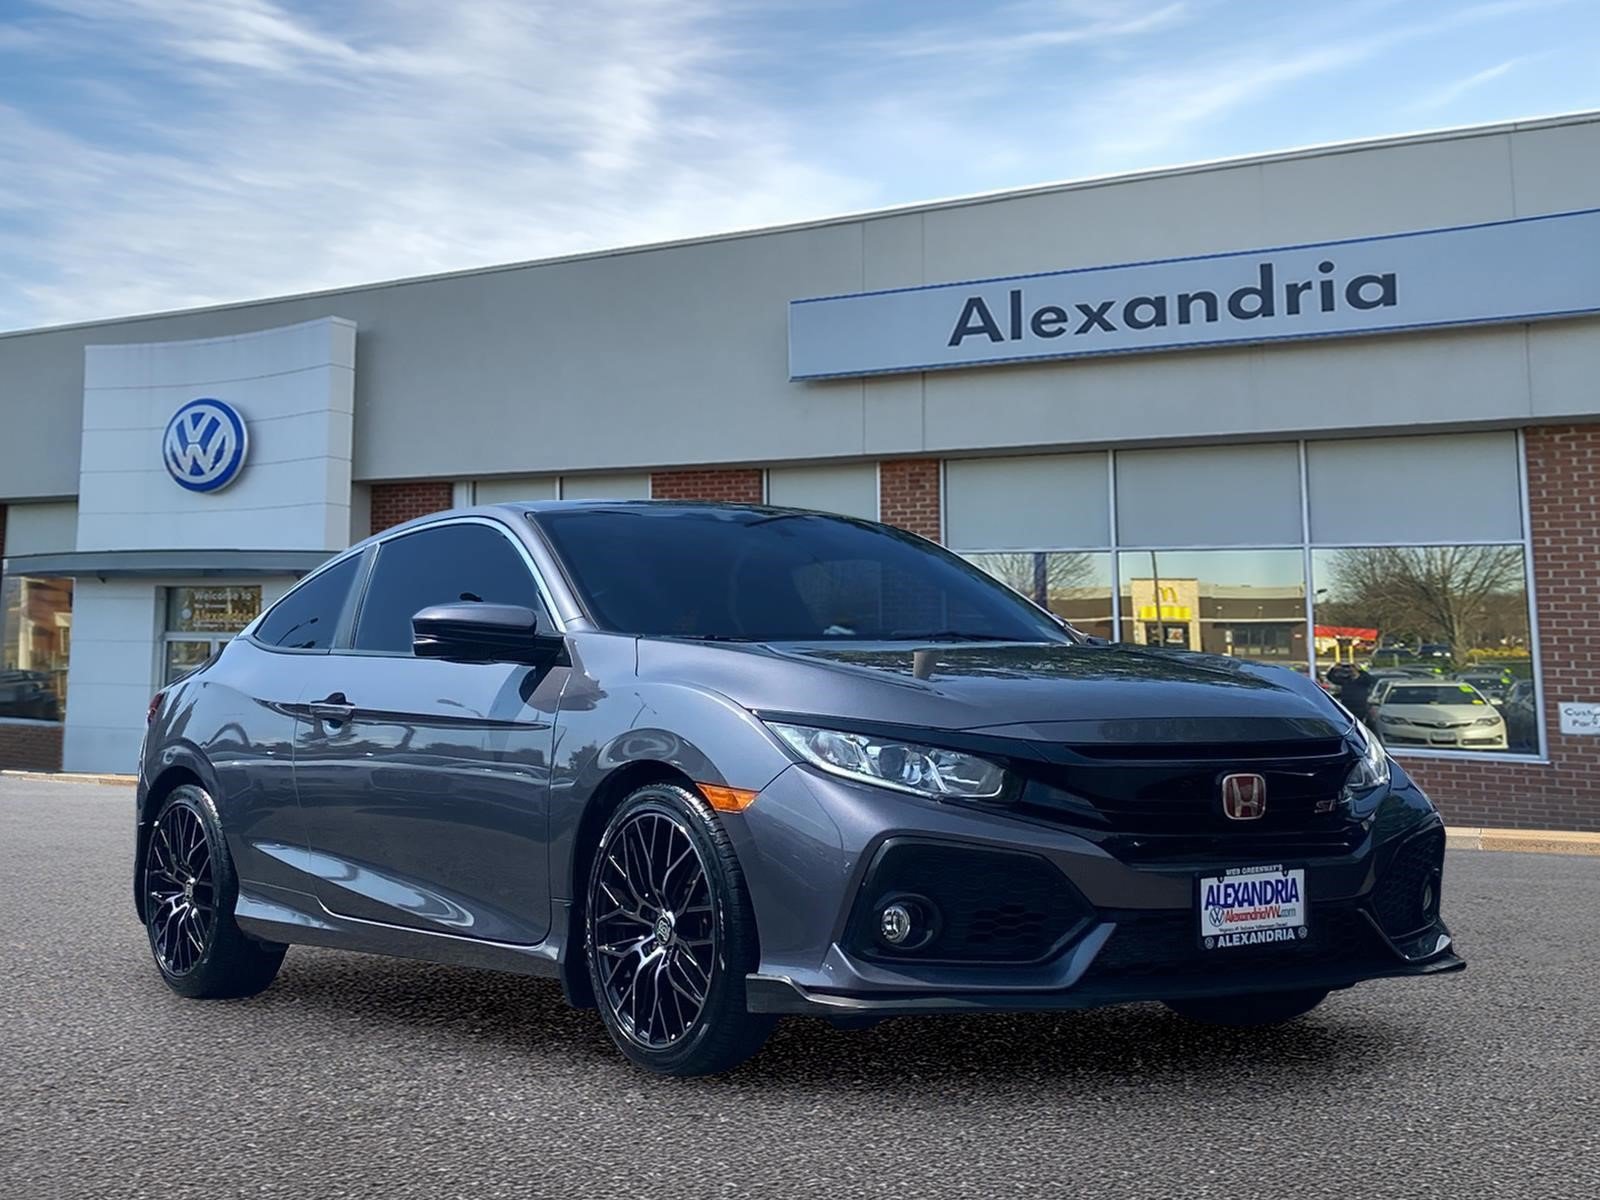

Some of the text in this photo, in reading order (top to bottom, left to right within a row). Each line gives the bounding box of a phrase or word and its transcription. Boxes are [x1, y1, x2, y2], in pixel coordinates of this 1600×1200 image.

[947, 260, 1399, 347] Alexandria
[1204, 877, 1300, 911] ALEXANDRIA
[1217, 928, 1296, 948] ALEXANDRIA
